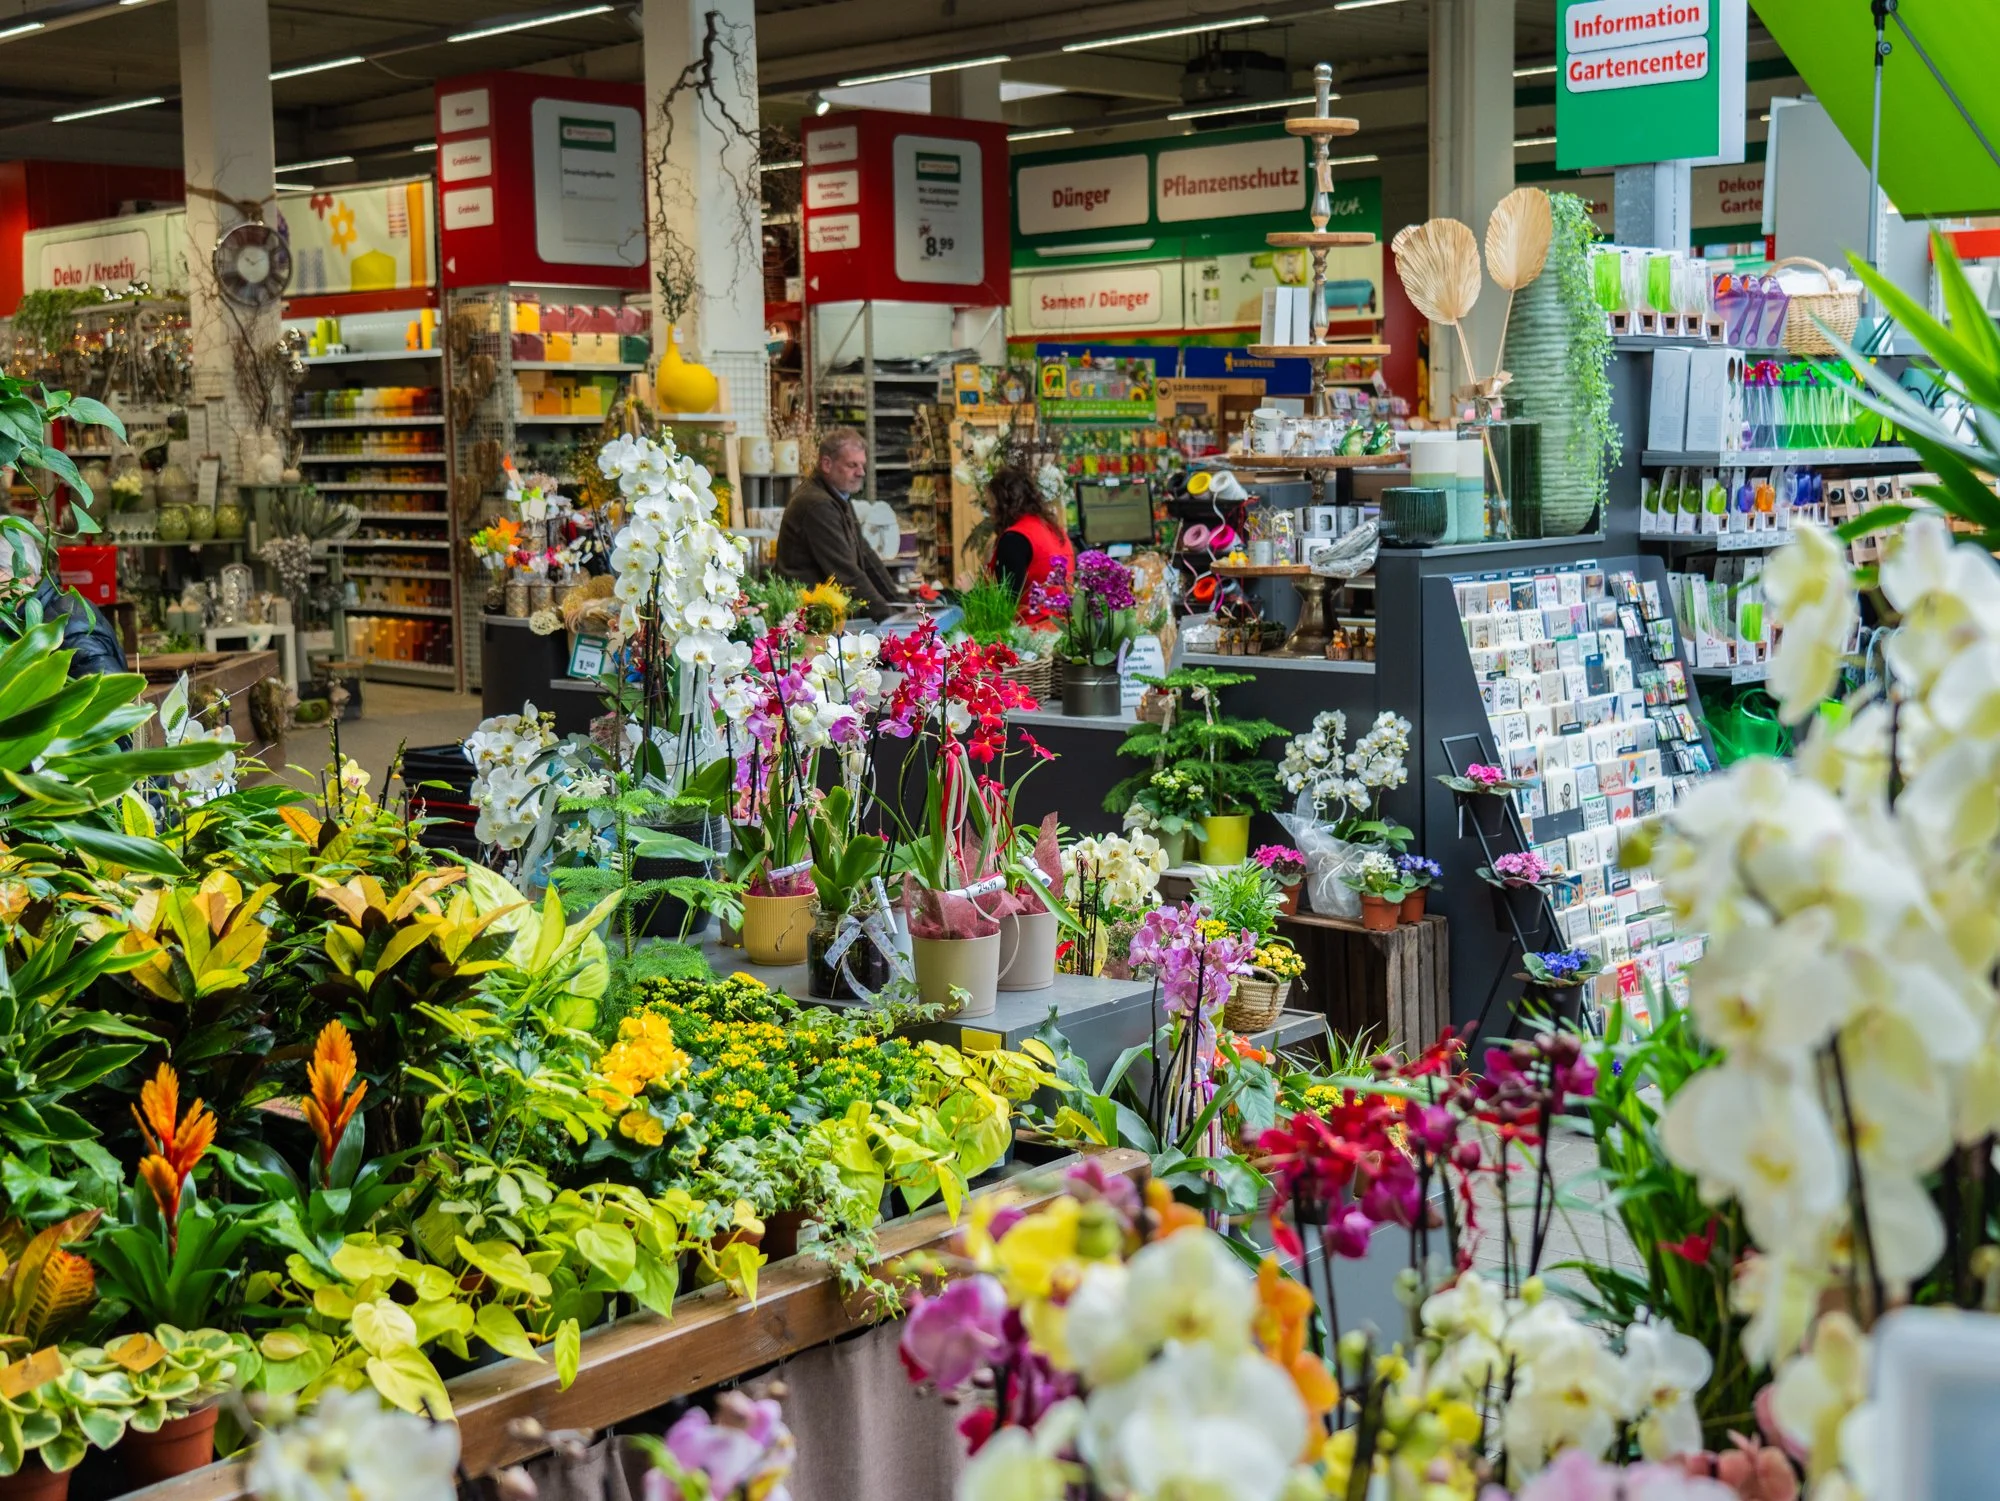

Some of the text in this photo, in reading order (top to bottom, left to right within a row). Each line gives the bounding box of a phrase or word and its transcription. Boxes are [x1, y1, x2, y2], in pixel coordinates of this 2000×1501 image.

[1574, 5, 1700, 39] Information
[1569, 50, 1706, 82] Gartencenter
[1163, 167, 1299, 198] Pflanzenschutz
[1052, 187, 1111, 211] Dünger
[926, 237, 955, 256] 8.99
[53, 264, 82, 287] Deko
[94, 256, 135, 281] Kreativ
[1041, 294, 1086, 311] Samen
[1099, 292, 1150, 311] Dünger
